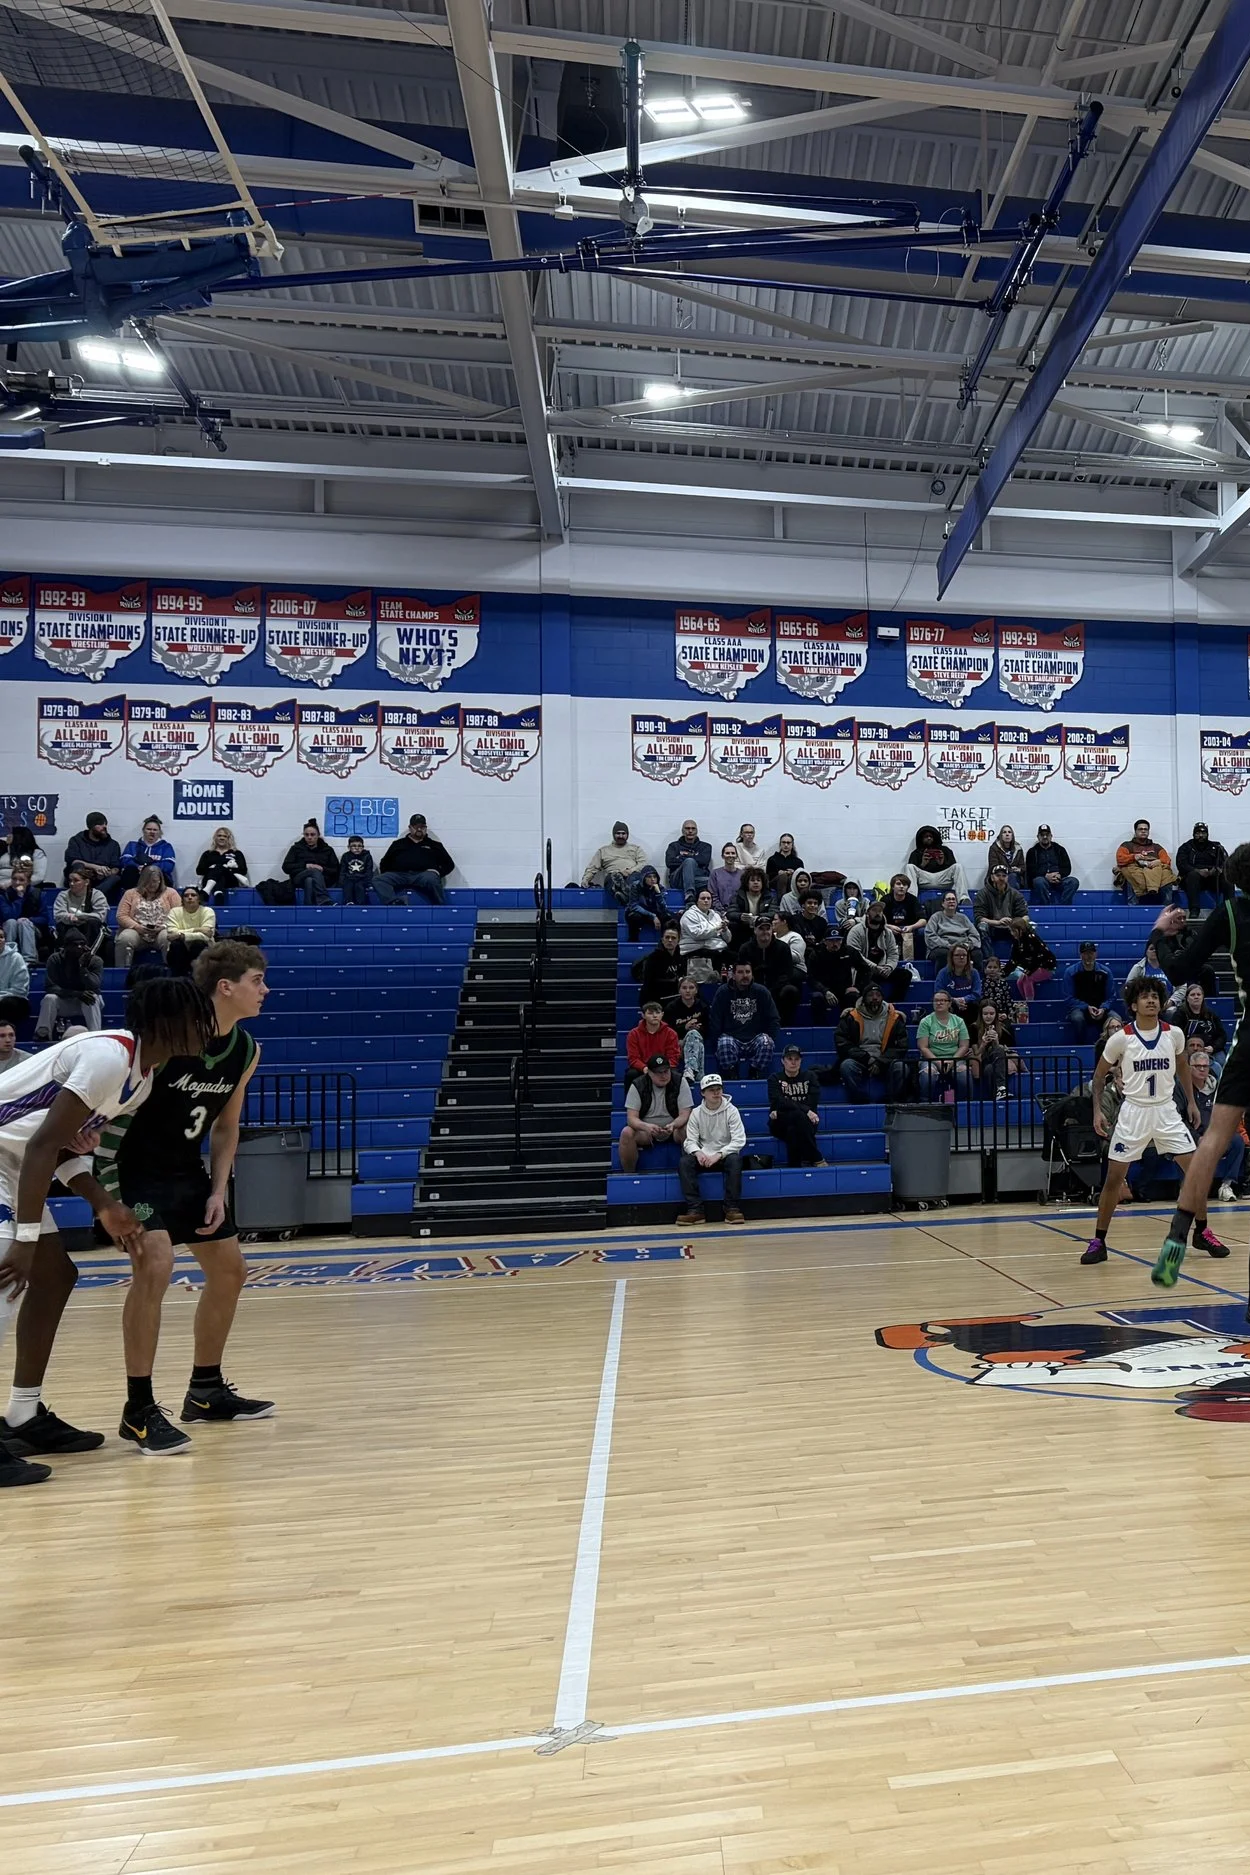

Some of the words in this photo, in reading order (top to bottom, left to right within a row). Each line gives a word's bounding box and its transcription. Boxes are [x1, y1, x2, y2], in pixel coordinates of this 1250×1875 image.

[40, 590, 85, 607] 1992-93
[157, 595, 202, 611] 1994-95
[270, 599, 316, 615] 2006-07
[381, 601, 402, 610] TEAM
[69, 612, 103, 622] DIVISION
[380, 609, 403, 618] STATE
[406, 610, 439, 620] CHAMPS
[185, 617, 219, 626] DIVISION
[297, 621, 331, 630] DIVISION
[679, 616, 719, 631] 1964-65
[39, 624, 72, 638] STATE
[75, 625, 140, 640] CHAMPIONS
[779, 621, 818, 636] 1965-66
[154, 626, 187, 642] STATE
[190, 627, 256, 644] RUNNER-UP
[268, 630, 299, 645] STATE
[303, 631, 366, 648] RUNNER-UP
[397, 628, 458, 647] WHO'S
[910, 628, 944, 641] 1976-77
[1002, 632, 1037, 645] 1992-93
[71, 640, 109, 649] WRESTLING
[704, 637, 725, 646] CLASS
[804, 642, 824, 650] CLASS
[187, 644, 224, 653] WRESTLING
[299, 648, 336, 657] WRESTLING
[933, 647, 952, 655] CLASS
[399, 648, 456, 666] NEXT?
[682, 646, 710, 660] STATE
[712, 647, 764, 663] CHAMPION
[782, 651, 809, 664] STATE
[812, 651, 861, 667] CHAMPION
[912, 656, 938, 669] STATE
[941, 657, 988, 671] CHAMPION
[1004, 659, 1030, 673] STATE
[1032, 660, 1078, 674] CHAMPION
[43, 704, 79, 716] 1979-80
[131, 707, 166, 719] 1979-80
[217, 709, 251, 720] 1982-83
[302, 711, 335, 722] 1987-88
[384, 713, 417, 724] 1987-88
[466, 715, 498, 726] 1987-88
[636, 721, 666, 732] 1990-91
[713, 724, 741, 734] 1991-92
[787, 726, 816, 737] 1997-98
[54, 729, 108, 741] ALL-OHIO
[142, 730, 195, 743] ALL-OHIO
[228, 732, 280, 744] ALL-OHIO
[860, 728, 888, 738] 1997-98
[931, 730, 959, 741] 1999-00
[1000, 732, 1028, 743] 2002-03
[1067, 733, 1095, 744] 2002-03
[313, 735, 363, 746] ALL-OHIO
[395, 736, 444, 747] ALL-OHIO
[476, 738, 525, 749] ALL-OHIO
[1204, 737, 1231, 747] 2003-04
[647, 744, 692, 755] ALL-OHIO
[723, 746, 768, 757] ALL-OHIO
[797, 748, 841, 758] ALL-OHIO
[869, 750, 912, 760] ALL-OHIO
[940, 751, 982, 762] ALL-OHIO
[1009, 753, 1050, 763] ALL-OHIO
[1076, 754, 1116, 765] ALL-OHIO
[1213, 757, 1250, 767] ALL-OHIO
[182, 784, 225, 797] HOME
[28, 796, 47, 812] GO
[176, 802, 230, 815] ADULTS
[327, 800, 354, 815] GO
[360, 799, 396, 816] BIG
[940, 808, 976, 819] TAKE
[979, 807, 992, 818] IT
[333, 815, 394, 834] BLUE
[948, 820, 963, 831] TO
[966, 819, 986, 831] THE
[1133, 1058, 1169, 1072] RAVENS
[1145, 1073, 1156, 1097] 1
[184, 1106, 207, 1139] 3
